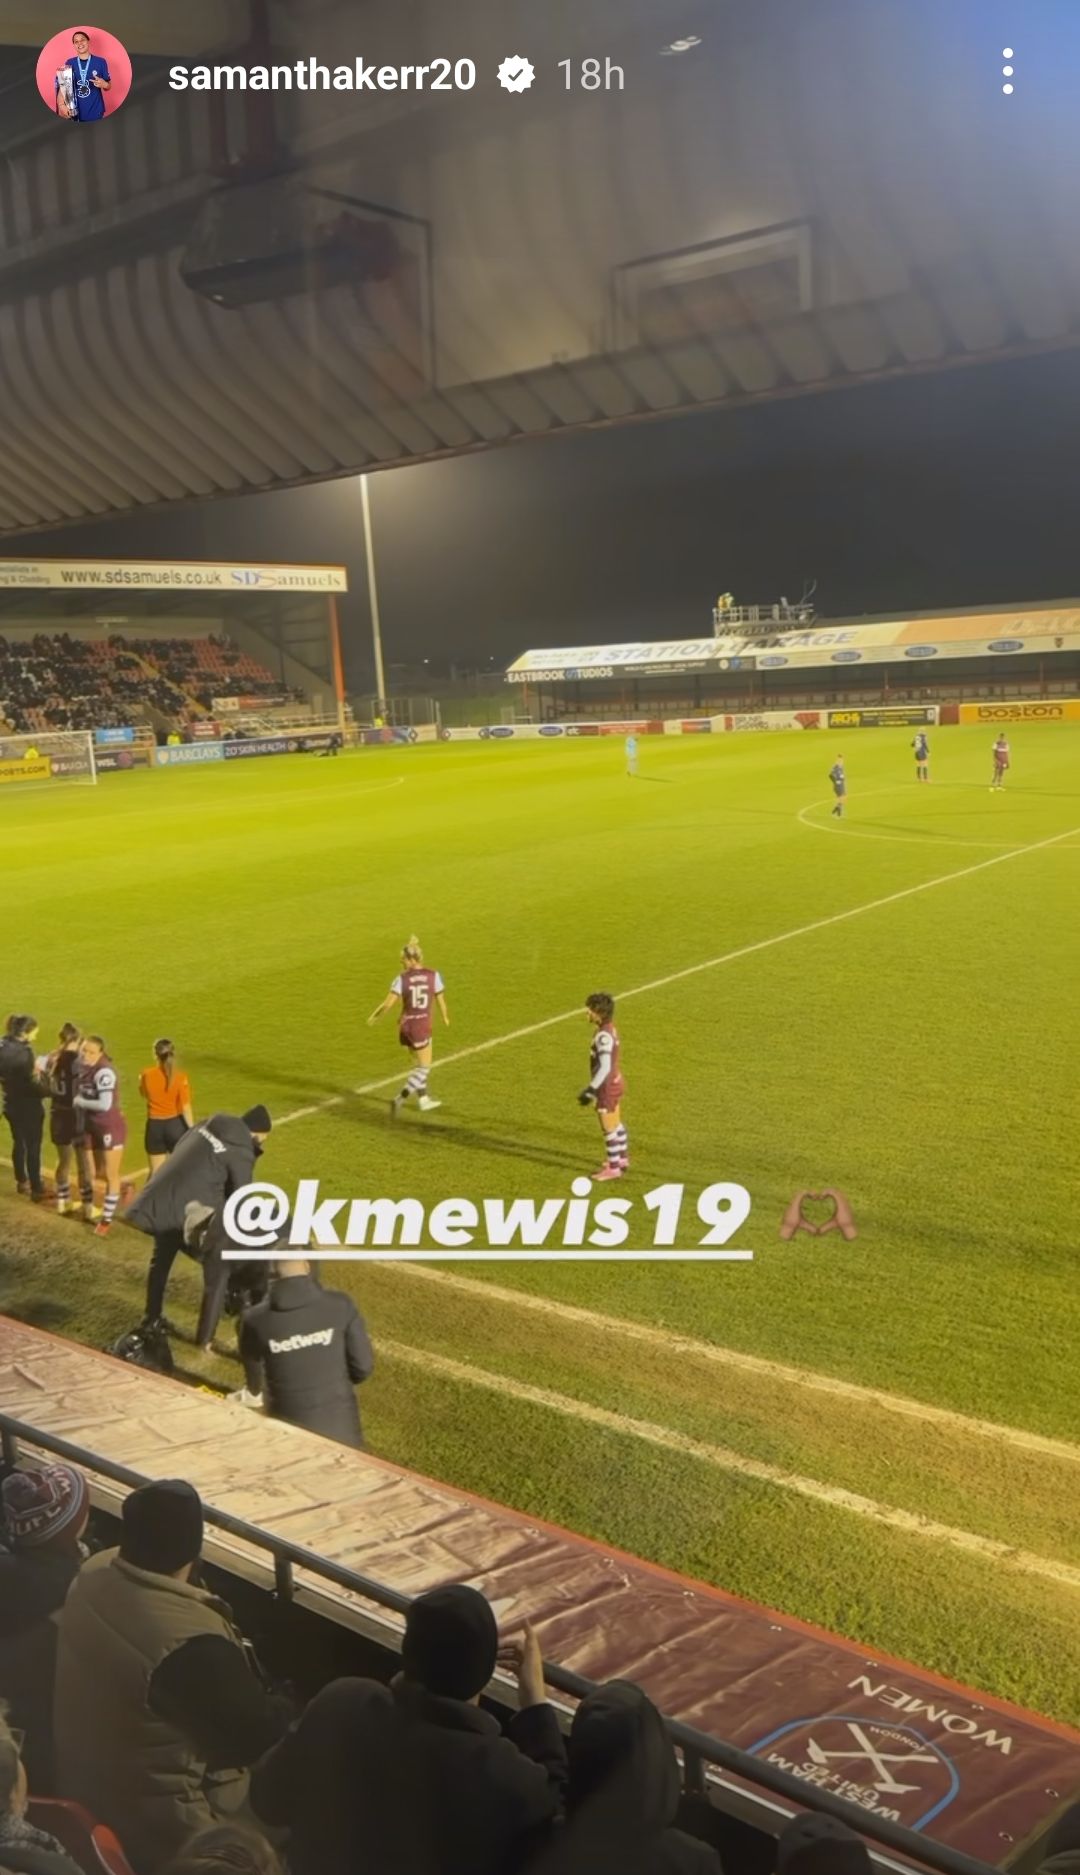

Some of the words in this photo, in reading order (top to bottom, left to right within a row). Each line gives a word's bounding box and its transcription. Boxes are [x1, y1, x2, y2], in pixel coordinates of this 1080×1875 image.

[61, 568, 222, 584] www.sdsamuels.co.uk
[507, 669, 565, 683] EASTBROOK
[978, 704, 1063, 719] boston
[170, 748, 221, 762] BARCLAYS
[409, 984, 429, 1009] 15
[268, 1327, 335, 1354] betway
[847, 1674, 1014, 1755] WOMEN
